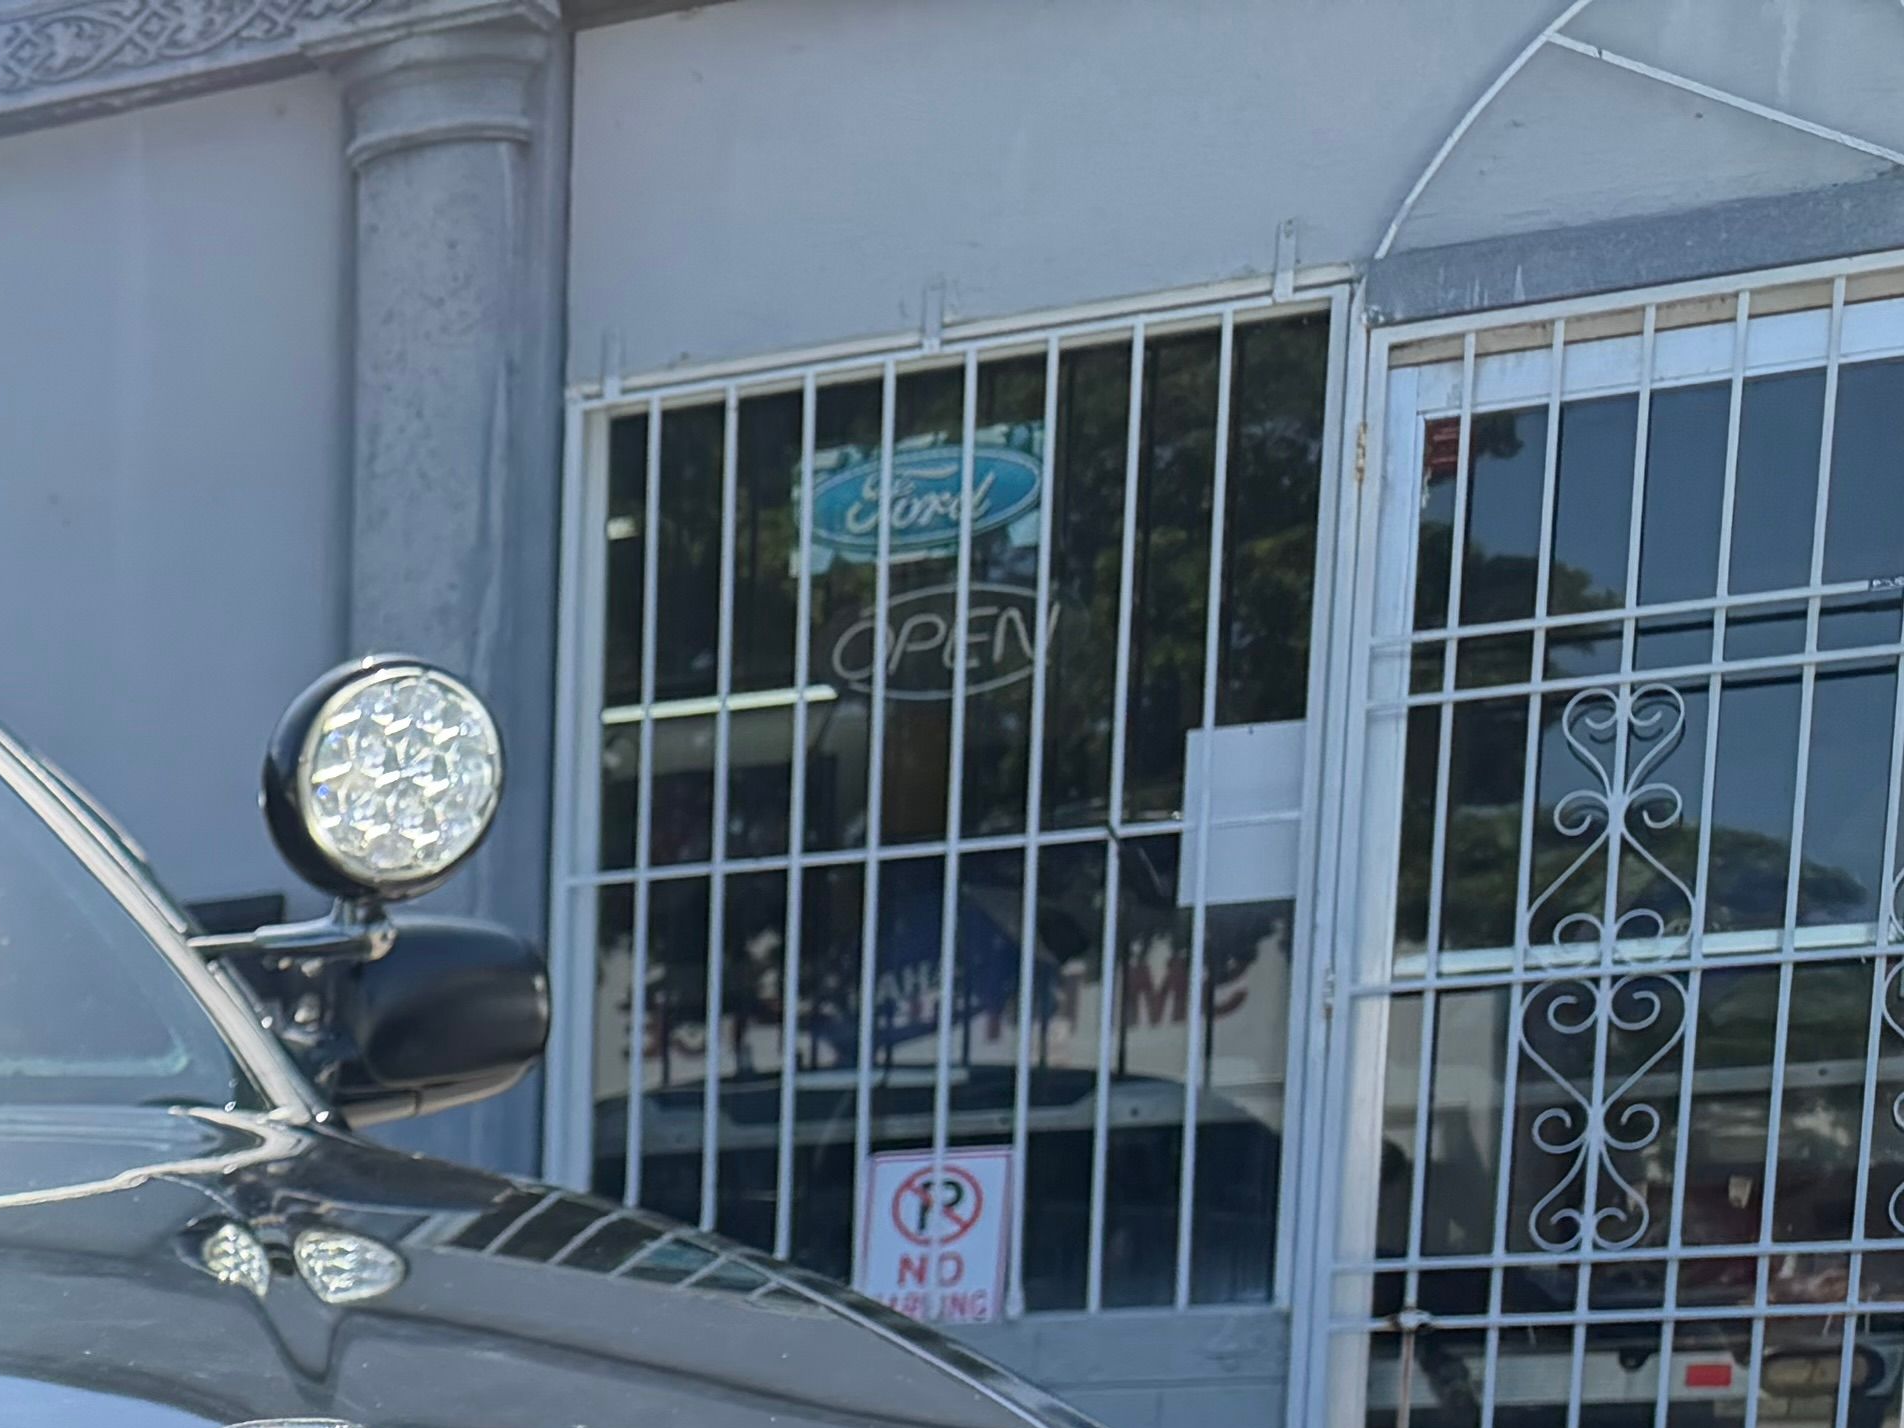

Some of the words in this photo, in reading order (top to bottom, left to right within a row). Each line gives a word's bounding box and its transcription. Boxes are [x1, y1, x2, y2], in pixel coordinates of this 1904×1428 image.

[846, 462, 996, 535] Ford
[832, 602, 1061, 681] OPEN
[897, 1252, 966, 1289] NO
[877, 1288, 989, 1322] RING
